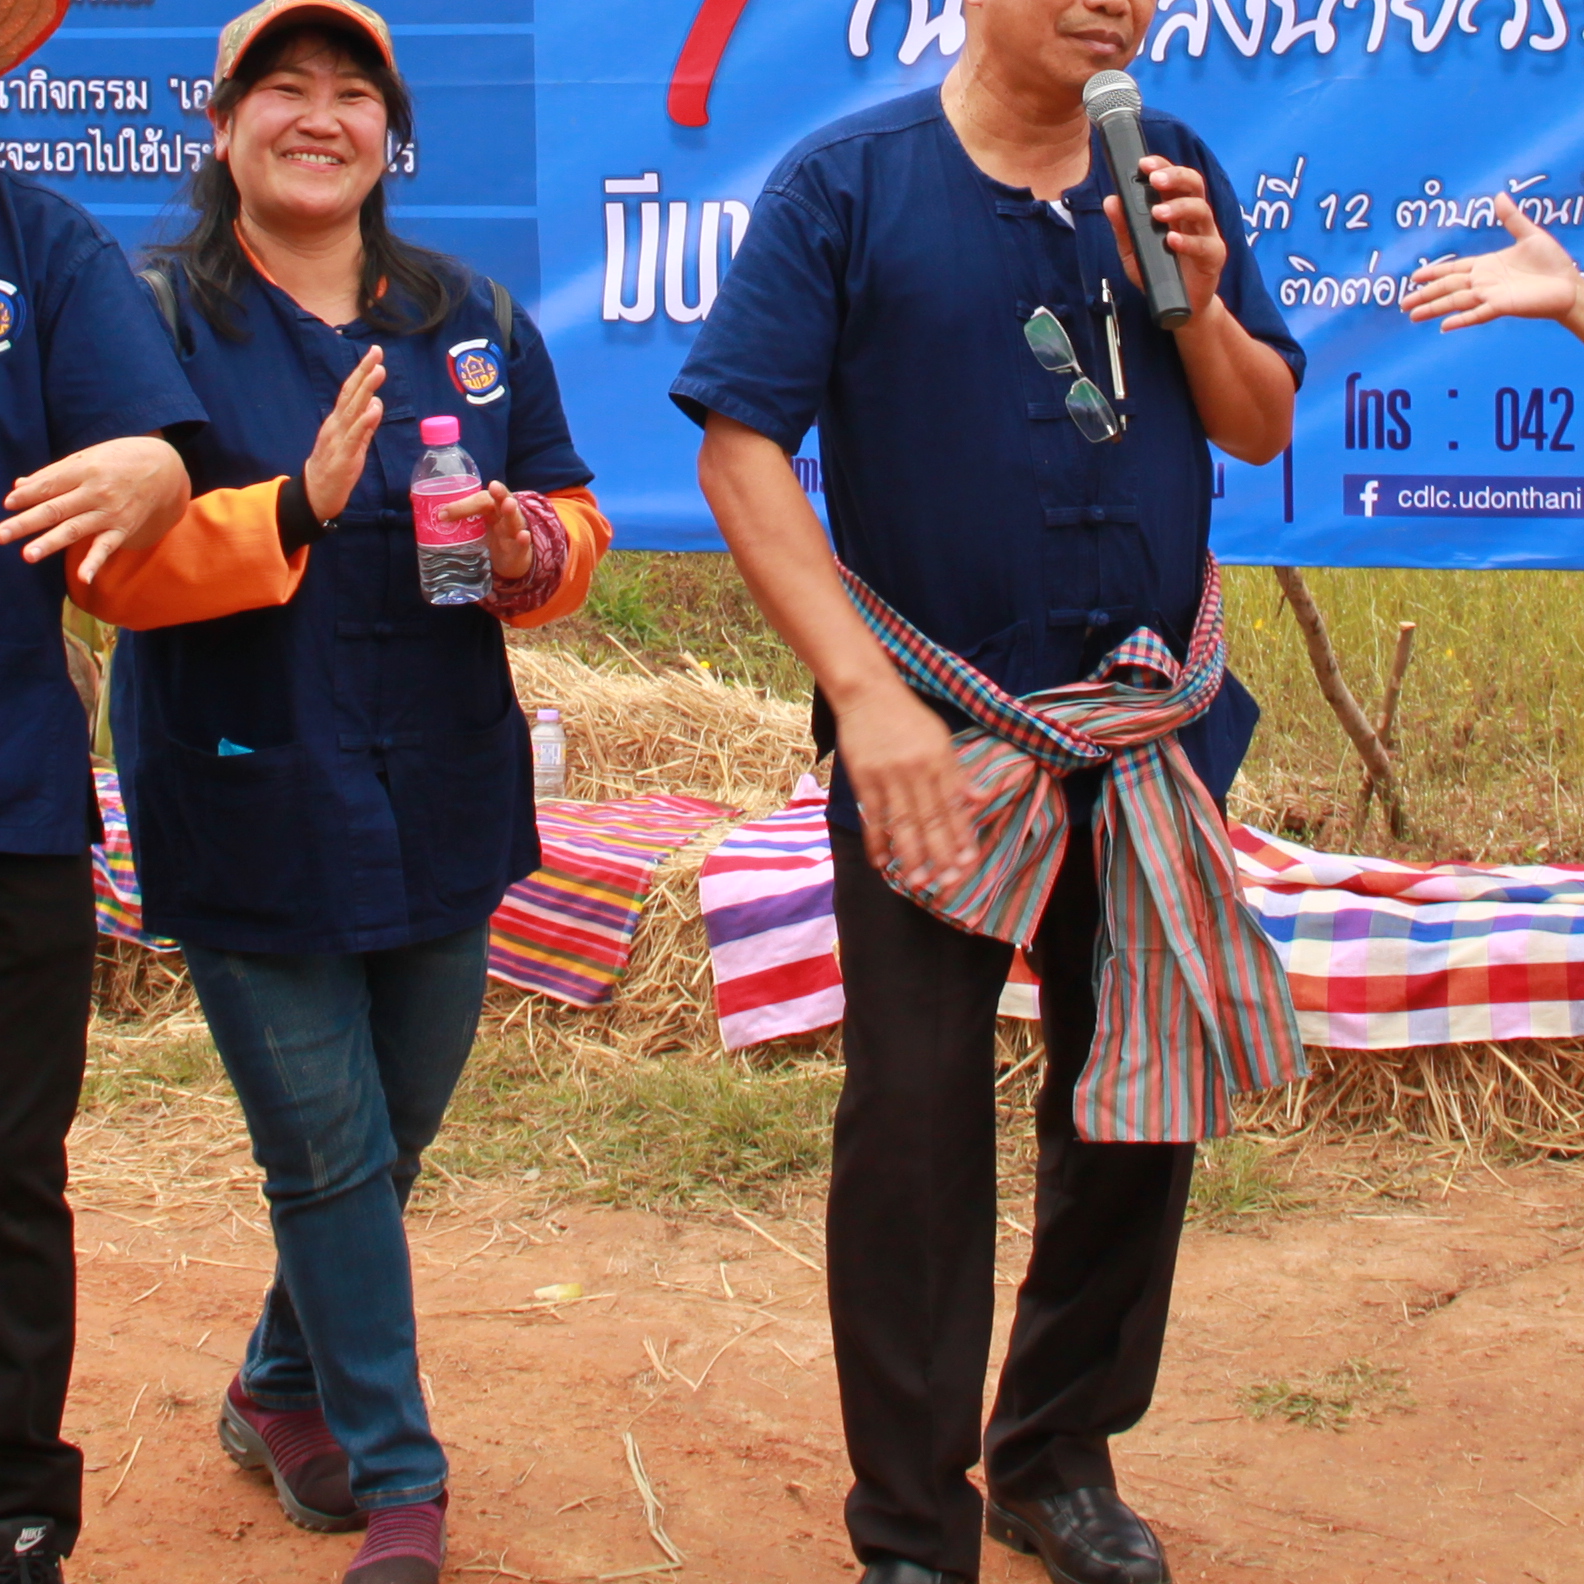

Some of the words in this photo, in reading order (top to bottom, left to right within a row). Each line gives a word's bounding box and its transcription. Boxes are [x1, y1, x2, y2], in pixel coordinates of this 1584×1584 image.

[1319, 192, 1370, 230] 12
[1493, 386, 1576, 453] 042
[1397, 485, 1583, 510] cdlc.udonthani
